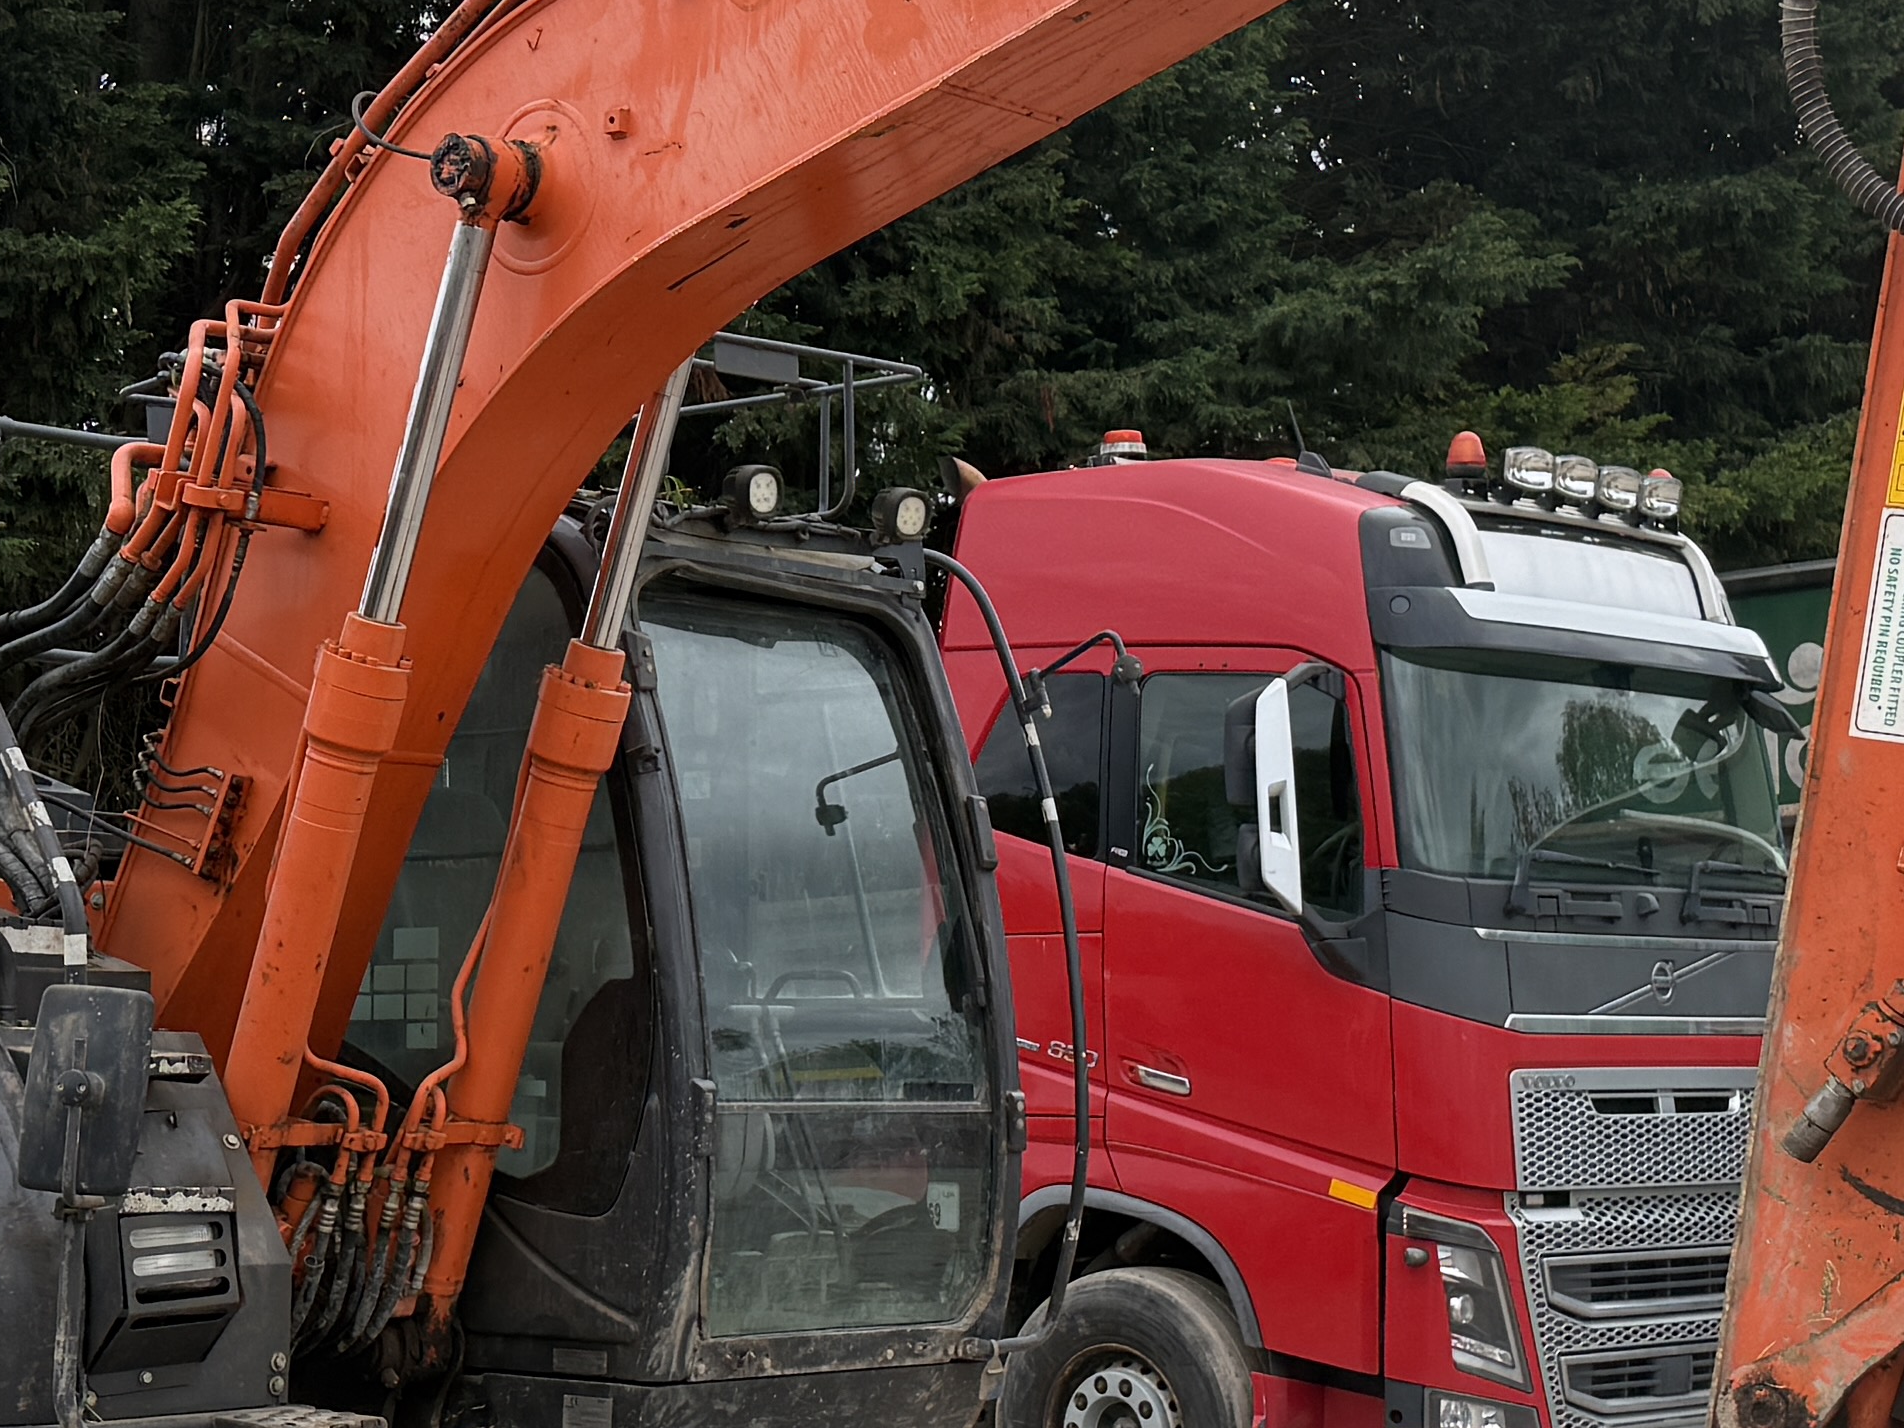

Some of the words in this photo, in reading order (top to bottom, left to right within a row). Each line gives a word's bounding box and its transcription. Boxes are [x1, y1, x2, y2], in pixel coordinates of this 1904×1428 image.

[1888, 547, 1903, 566] NO
[1881, 567, 1900, 614] SAFETY
[1877, 615, 1893, 638] PIN
[1868, 640, 1889, 704] REQUIRED
[1883, 685, 1901, 727] FITTED
